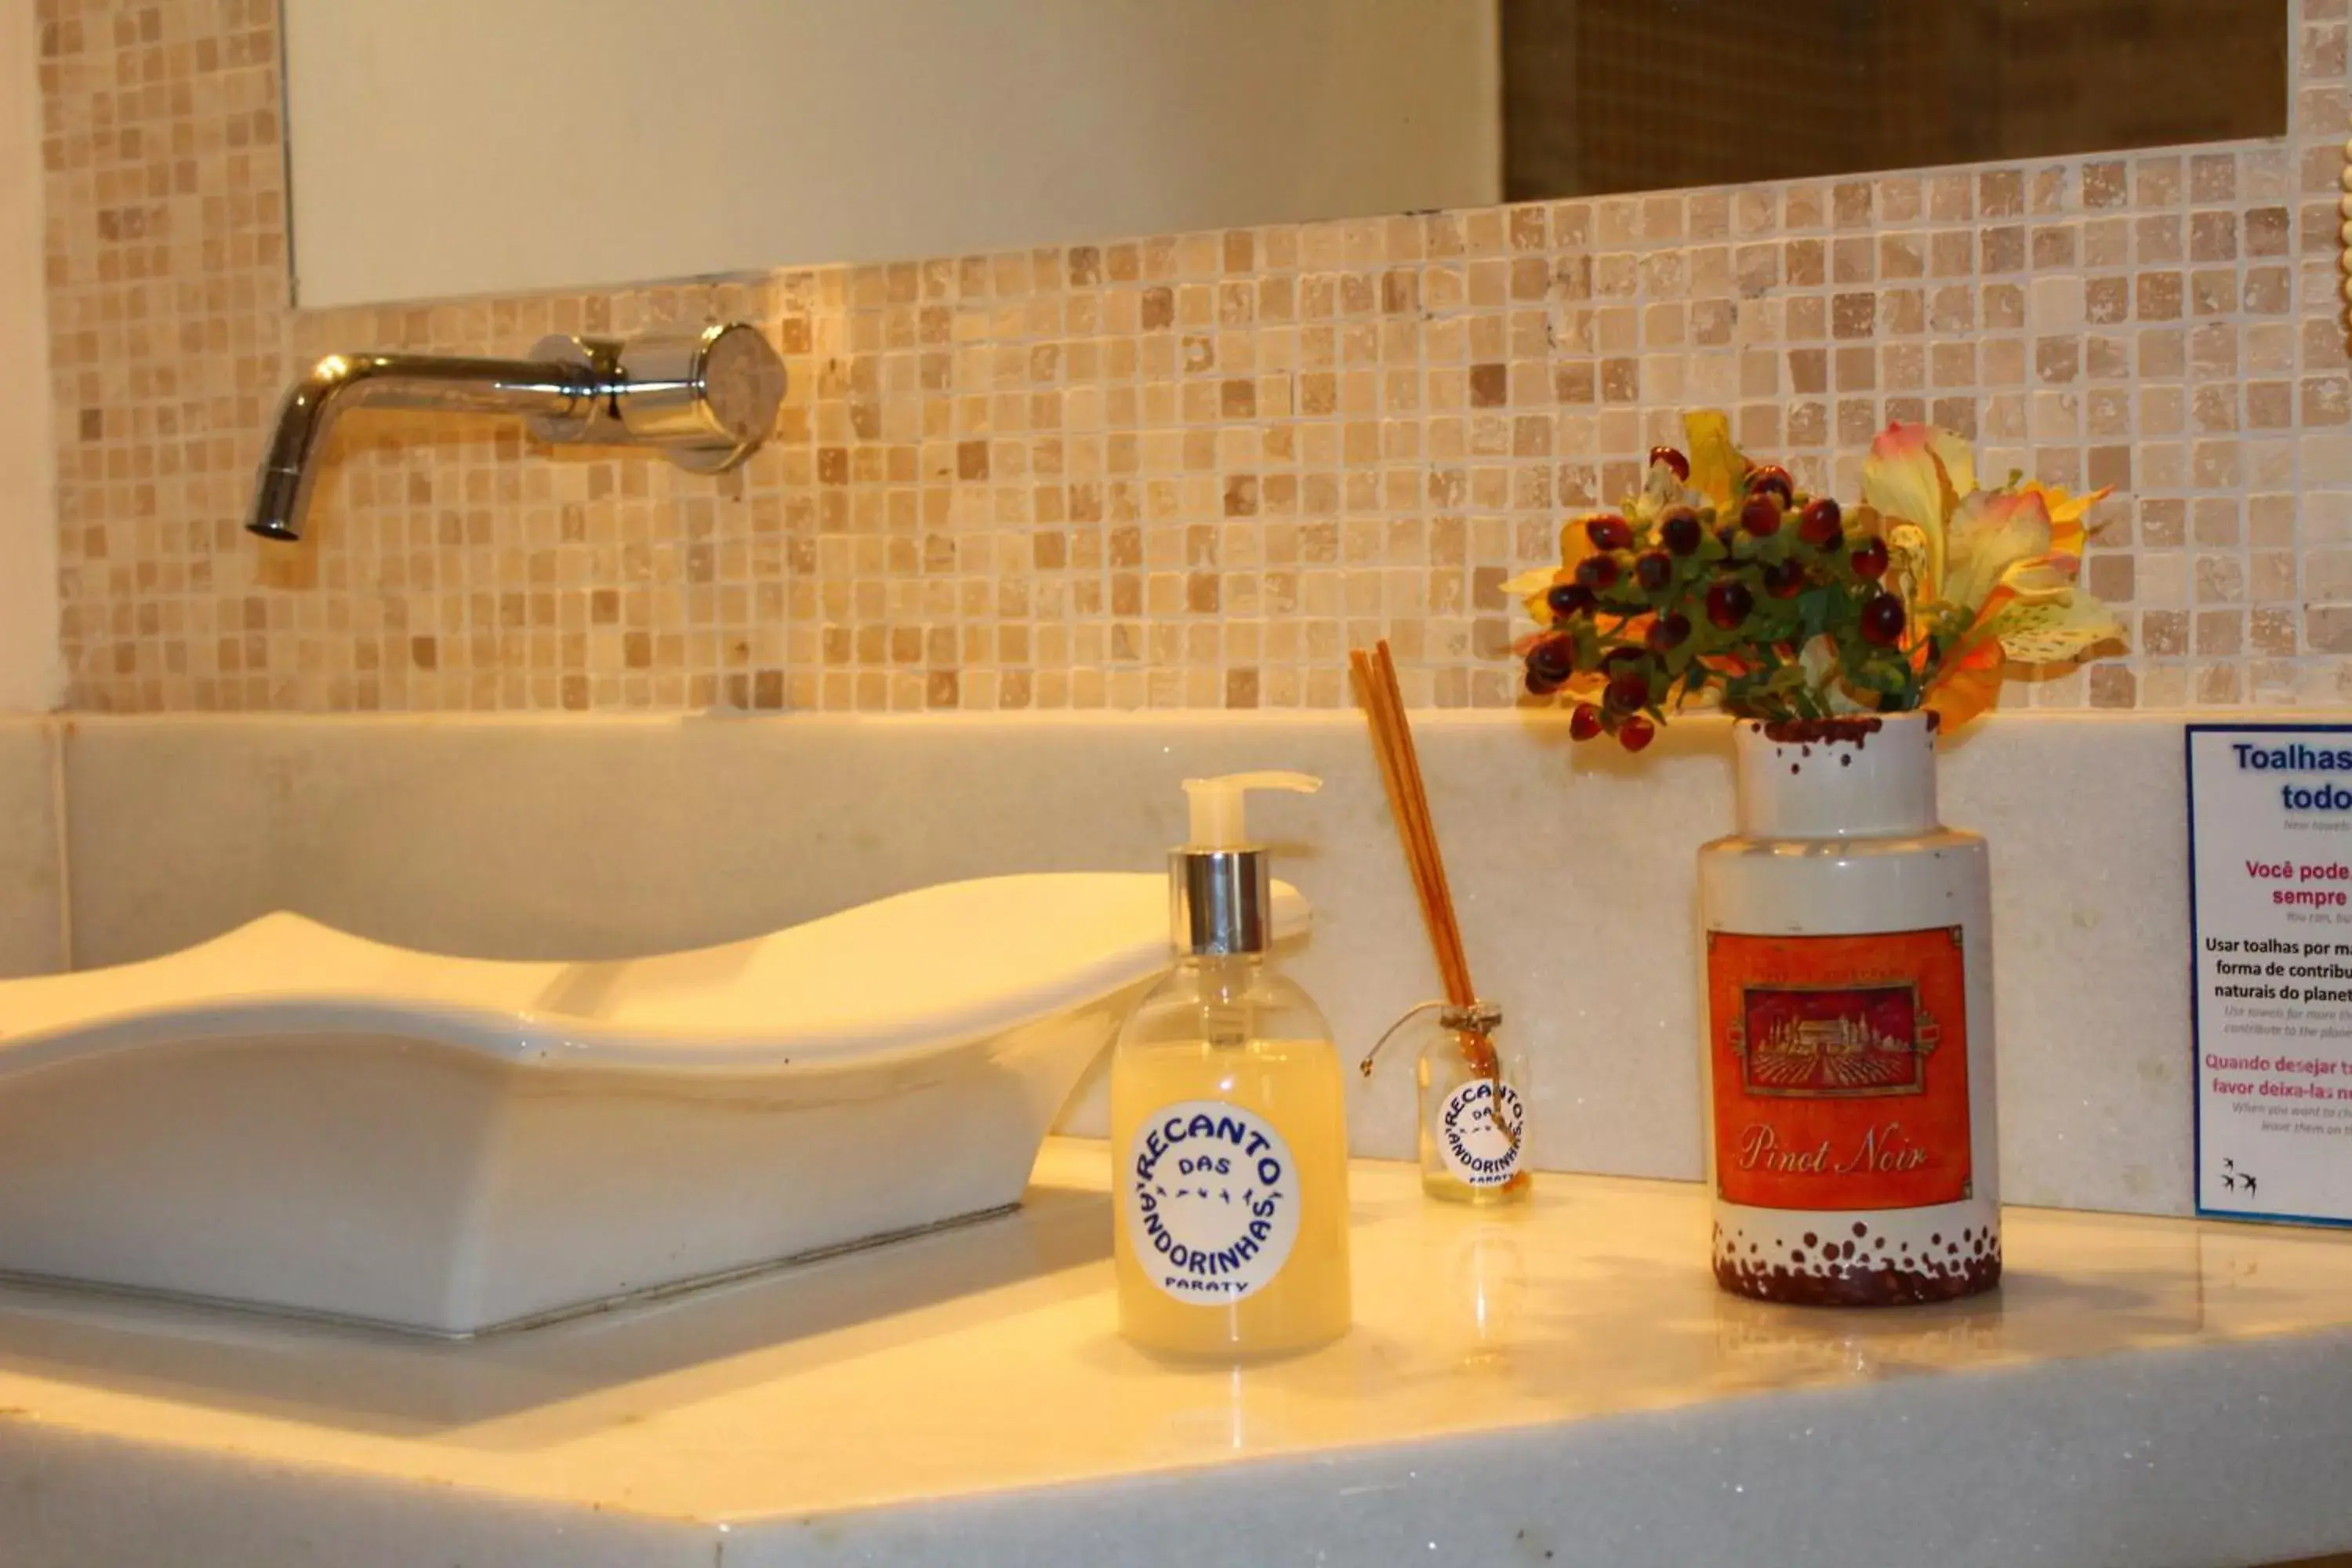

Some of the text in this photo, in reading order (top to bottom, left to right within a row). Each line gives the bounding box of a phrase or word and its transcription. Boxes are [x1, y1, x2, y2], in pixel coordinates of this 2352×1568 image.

[2233, 744, 2352, 771] Toalhas
[2282, 783, 2352, 810] todo
[2245, 859, 2352, 883] Você pode
[2273, 890, 2347, 909] sempre
[2205, 938, 2352, 957] Usar toalhas por m
[2216, 960, 2262, 976] forma
[2266, 962, 2285, 976] de
[2215, 984, 2276, 1000] naturais
[2279, 985, 2299, 1000] do
[2205, 1054, 2270, 1071] Quando
[2275, 1055, 2336, 1077] desejar
[2212, 1078, 2254, 1094] favor
[1472, 1106, 1493, 1120] DA
[1137, 1114, 1281, 1185] RECANTO
[1738, 1122, 1928, 1174] Pinot Noir
[1178, 1156, 1231, 1175] DAS
[1139, 1192, 1276, 1275] ANDORINHAS
[1165, 1276, 1249, 1292] PARATY
